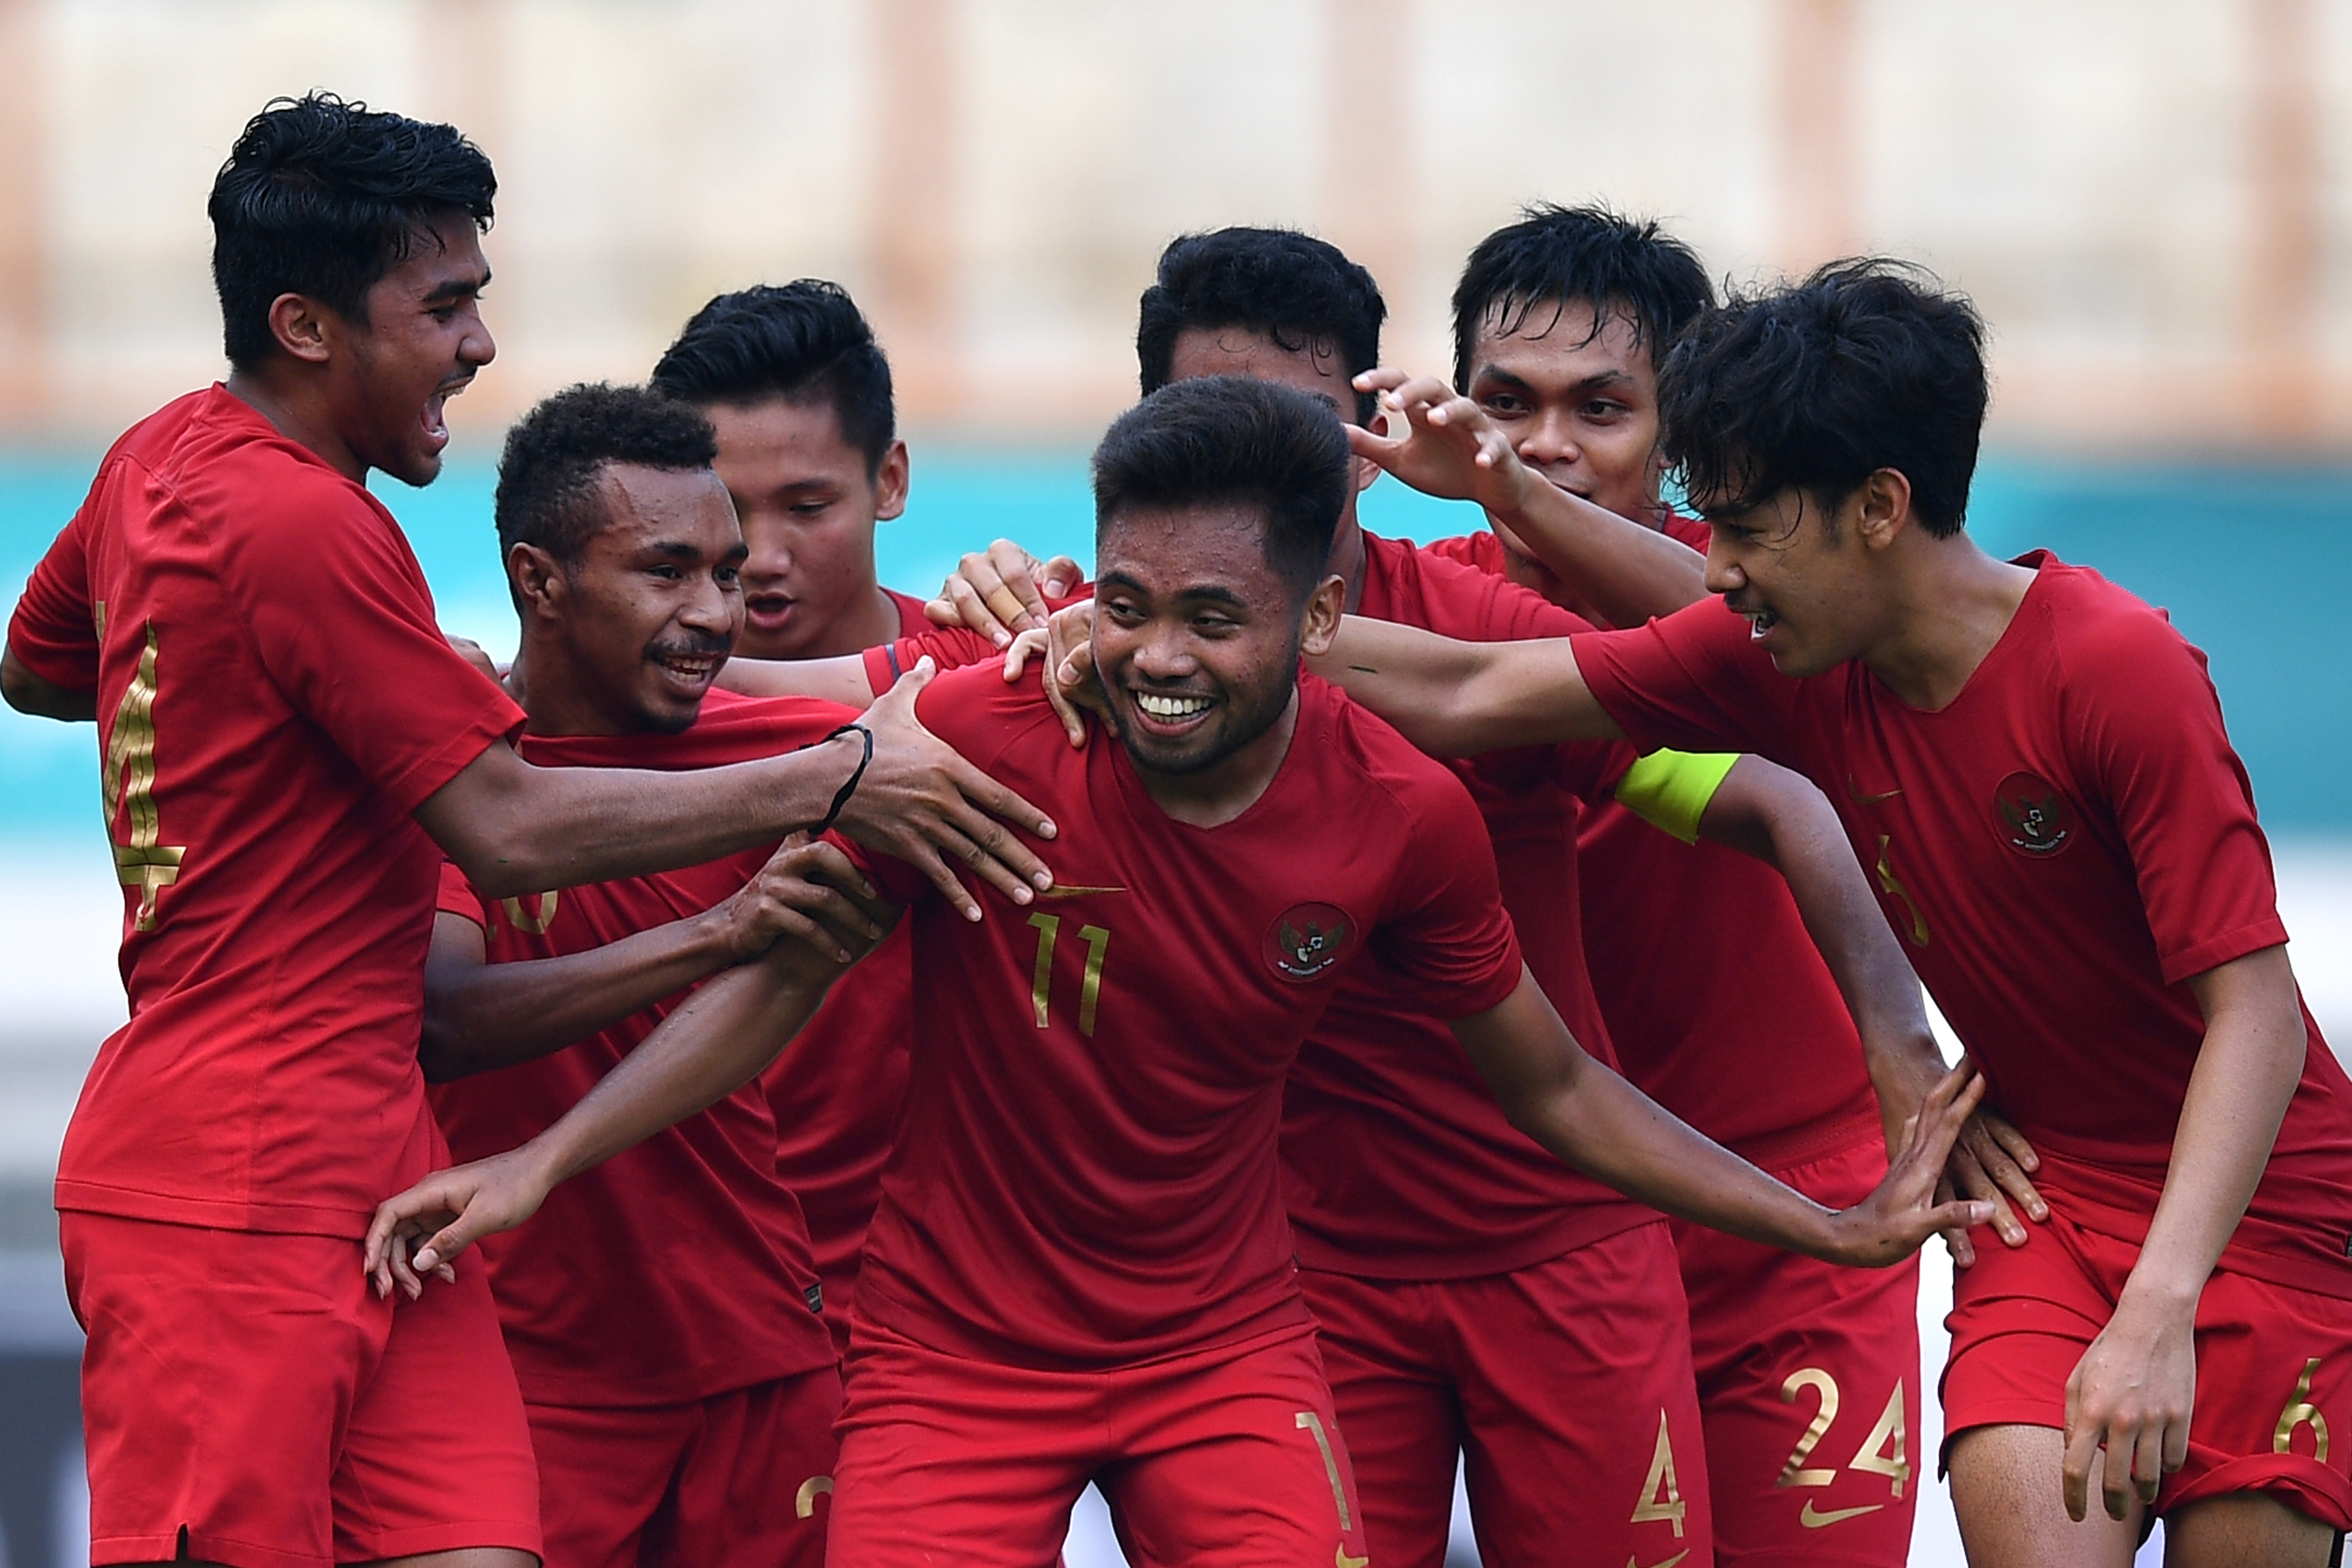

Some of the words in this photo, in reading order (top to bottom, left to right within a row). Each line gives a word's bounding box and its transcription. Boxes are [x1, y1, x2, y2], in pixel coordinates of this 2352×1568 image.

[95, 601, 187, 932] 4
[1027, 911, 1110, 1037] 11
[1295, 1412, 1355, 1532] 1
[1630, 1407, 1686, 1538] 4
[1775, 1368, 1910, 1498] 24
[2273, 1358, 2328, 1464] 6
